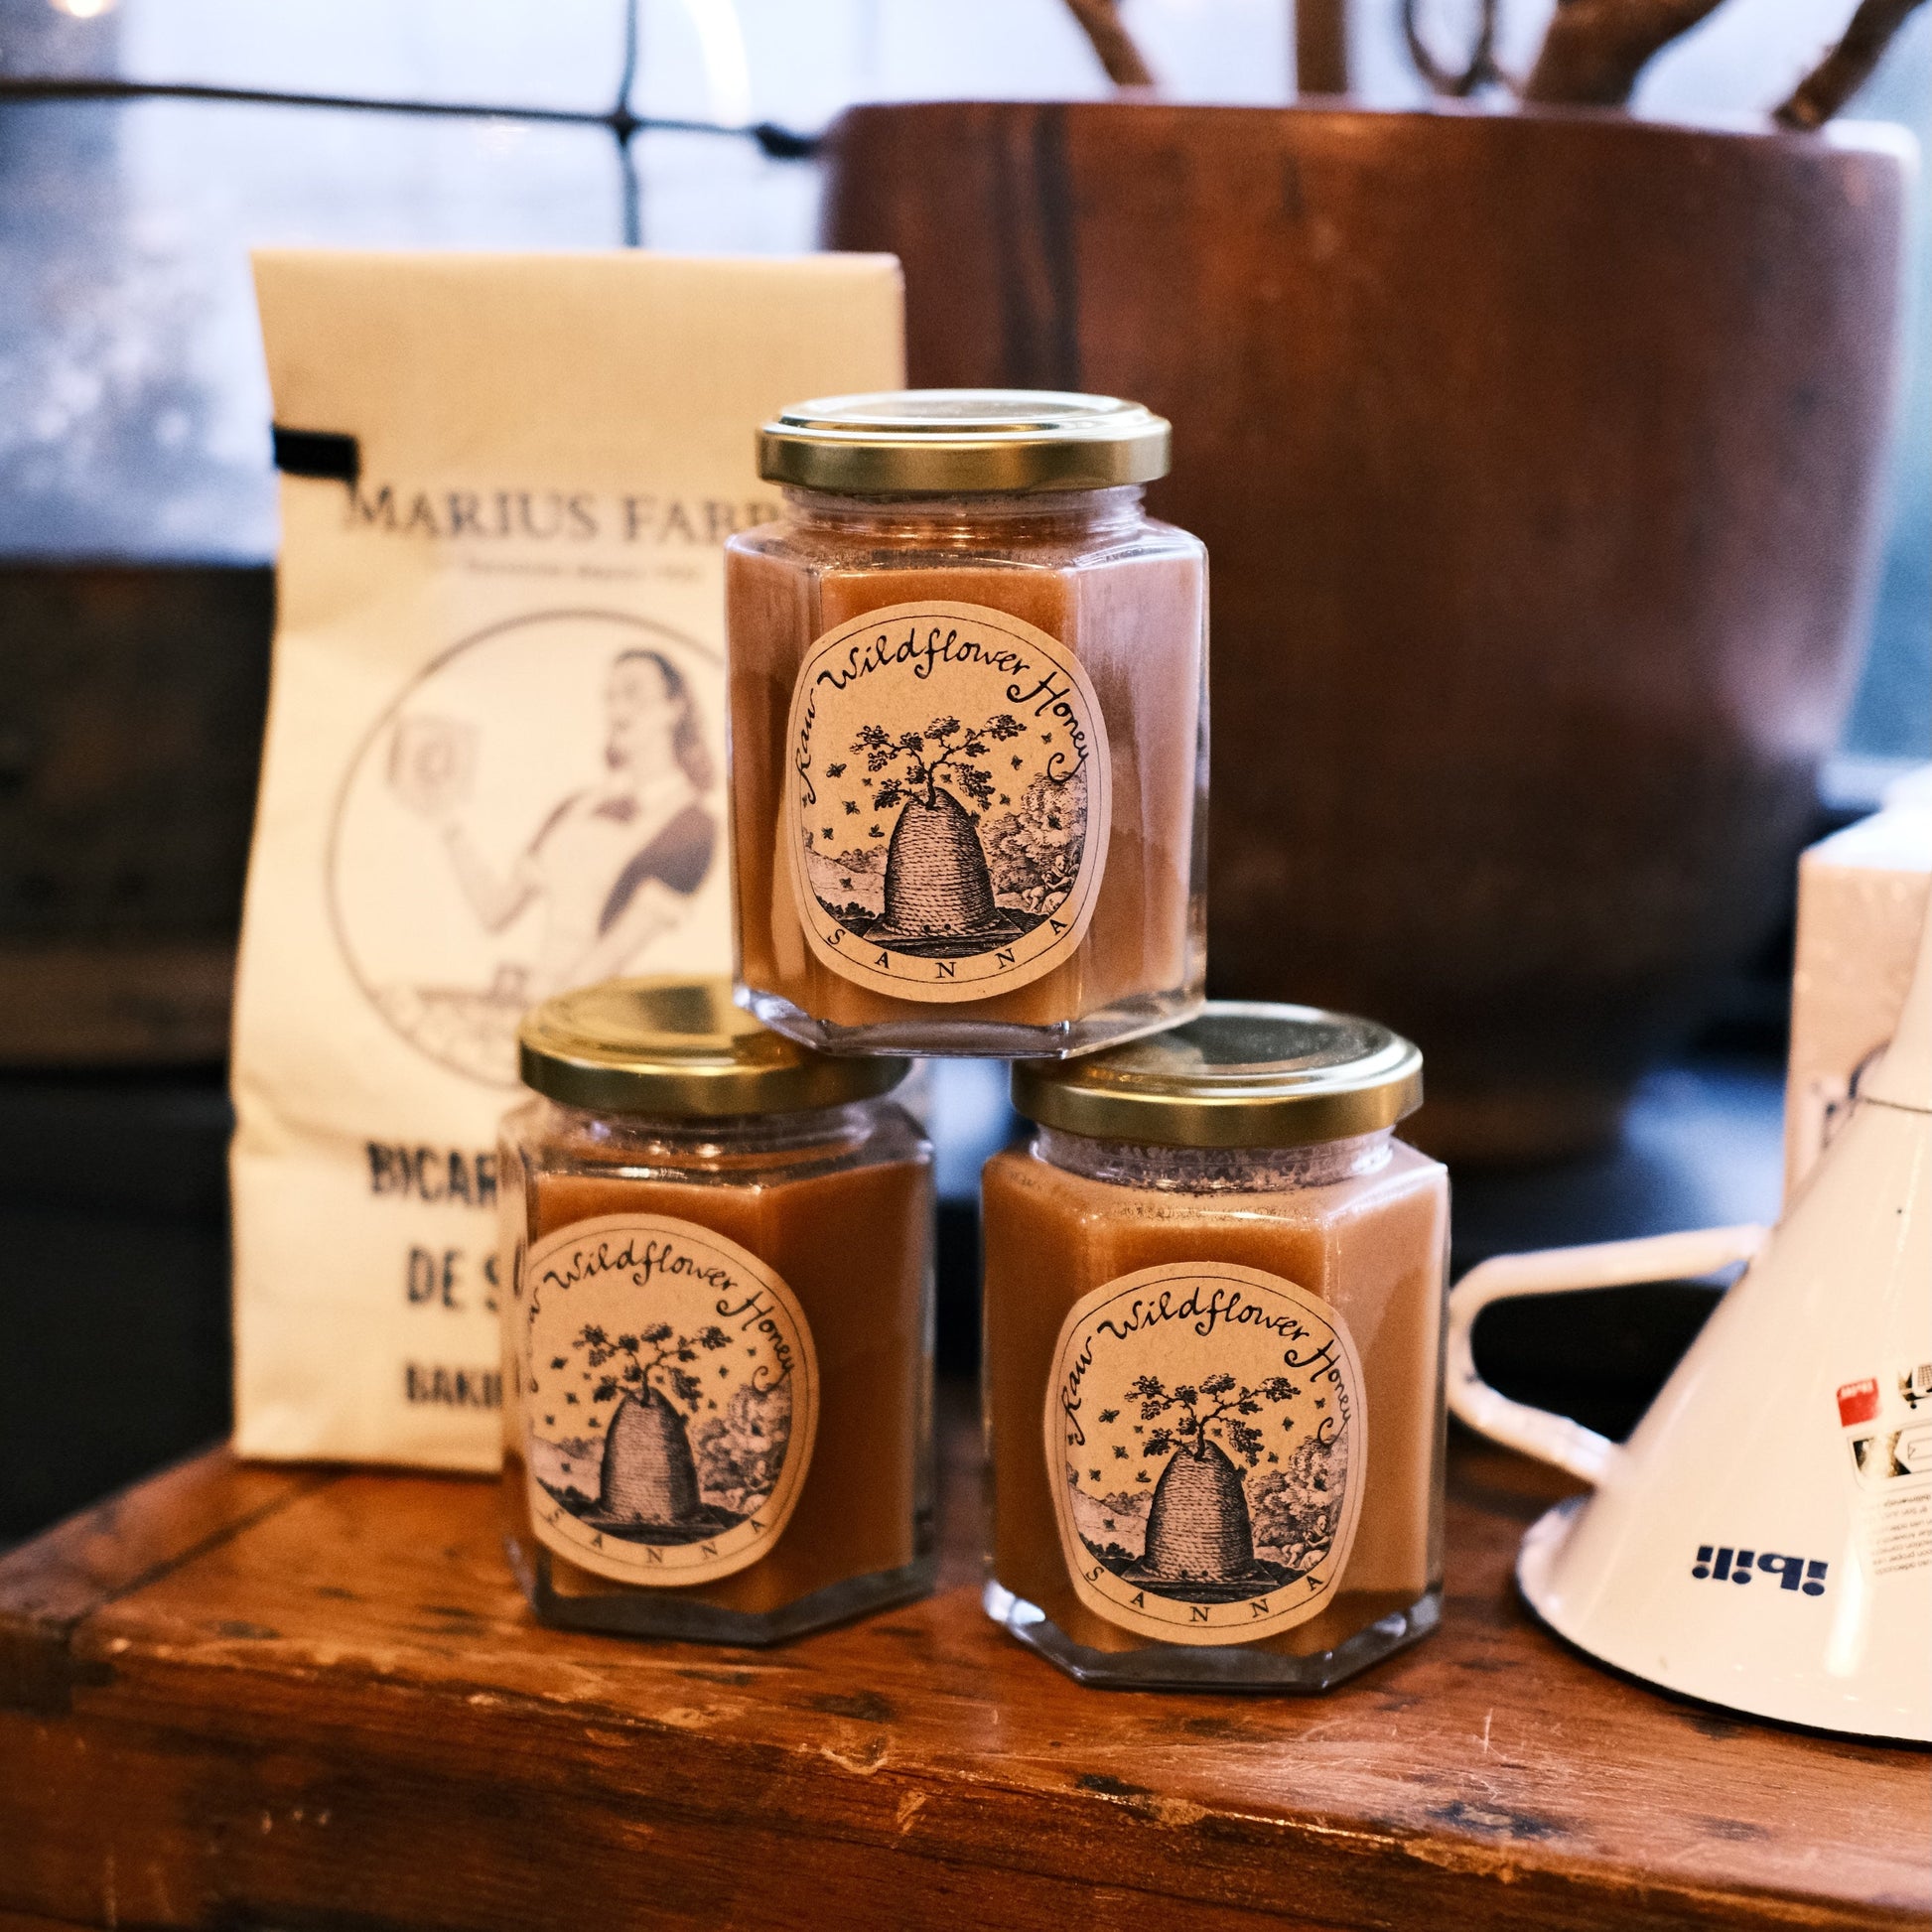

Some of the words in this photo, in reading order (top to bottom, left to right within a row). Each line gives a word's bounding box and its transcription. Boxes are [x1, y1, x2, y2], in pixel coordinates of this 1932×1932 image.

[341, 485, 599, 539] MARIUS
[795, 687, 819, 804] Raw
[817, 627, 1030, 690] Wildflower
[1006, 671, 1089, 787] Honey
[826, 918, 1067, 979] SANNA
[543, 1239, 739, 1291] Wildflower
[716, 1290, 795, 1392] Honey
[1063, 1335, 1093, 1447] Raw
[1096, 1286, 1310, 1341] Wildflower
[1283, 1337, 1352, 1447] Honey
[1085, 1564, 1323, 1622] SANNA
[1692, 1545, 1829, 1596] ibili
